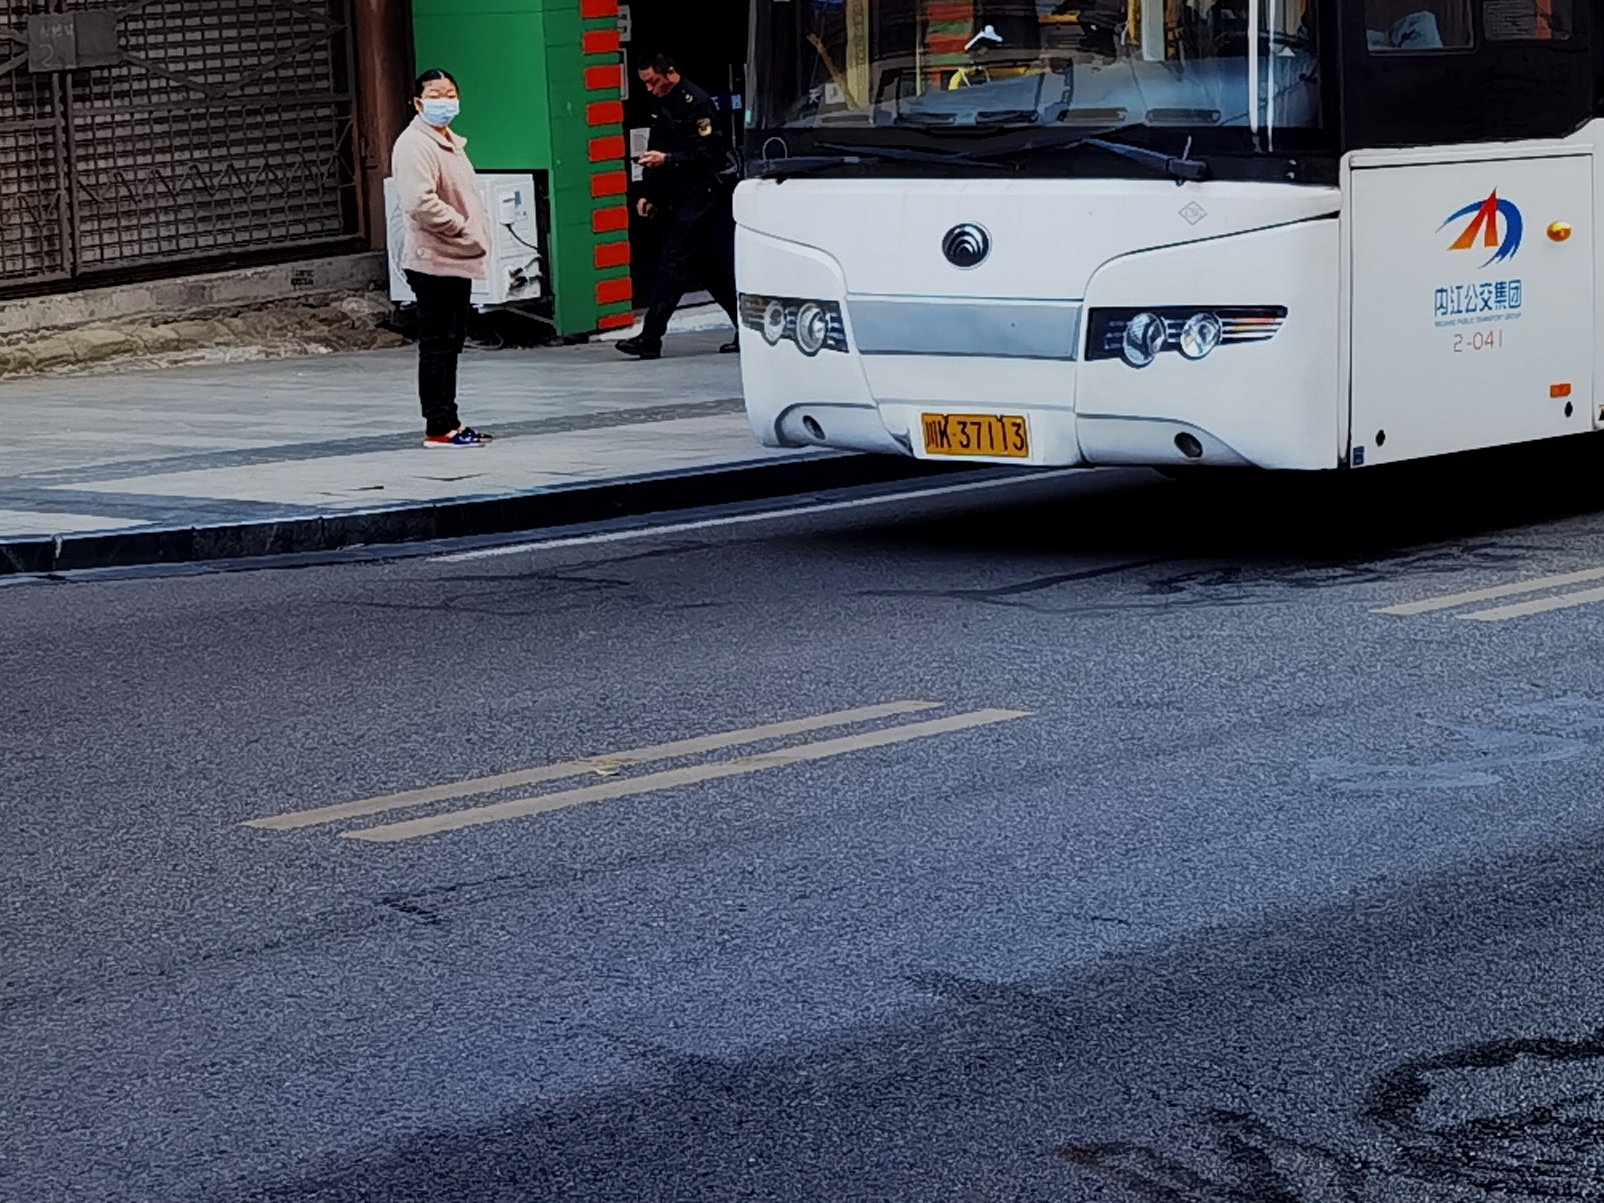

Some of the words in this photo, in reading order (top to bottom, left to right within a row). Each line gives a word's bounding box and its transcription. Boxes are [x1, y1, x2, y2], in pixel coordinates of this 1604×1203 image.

[1434, 279, 1522, 317] 内江公交集团
[1453, 328, 1503, 353] 2-041
